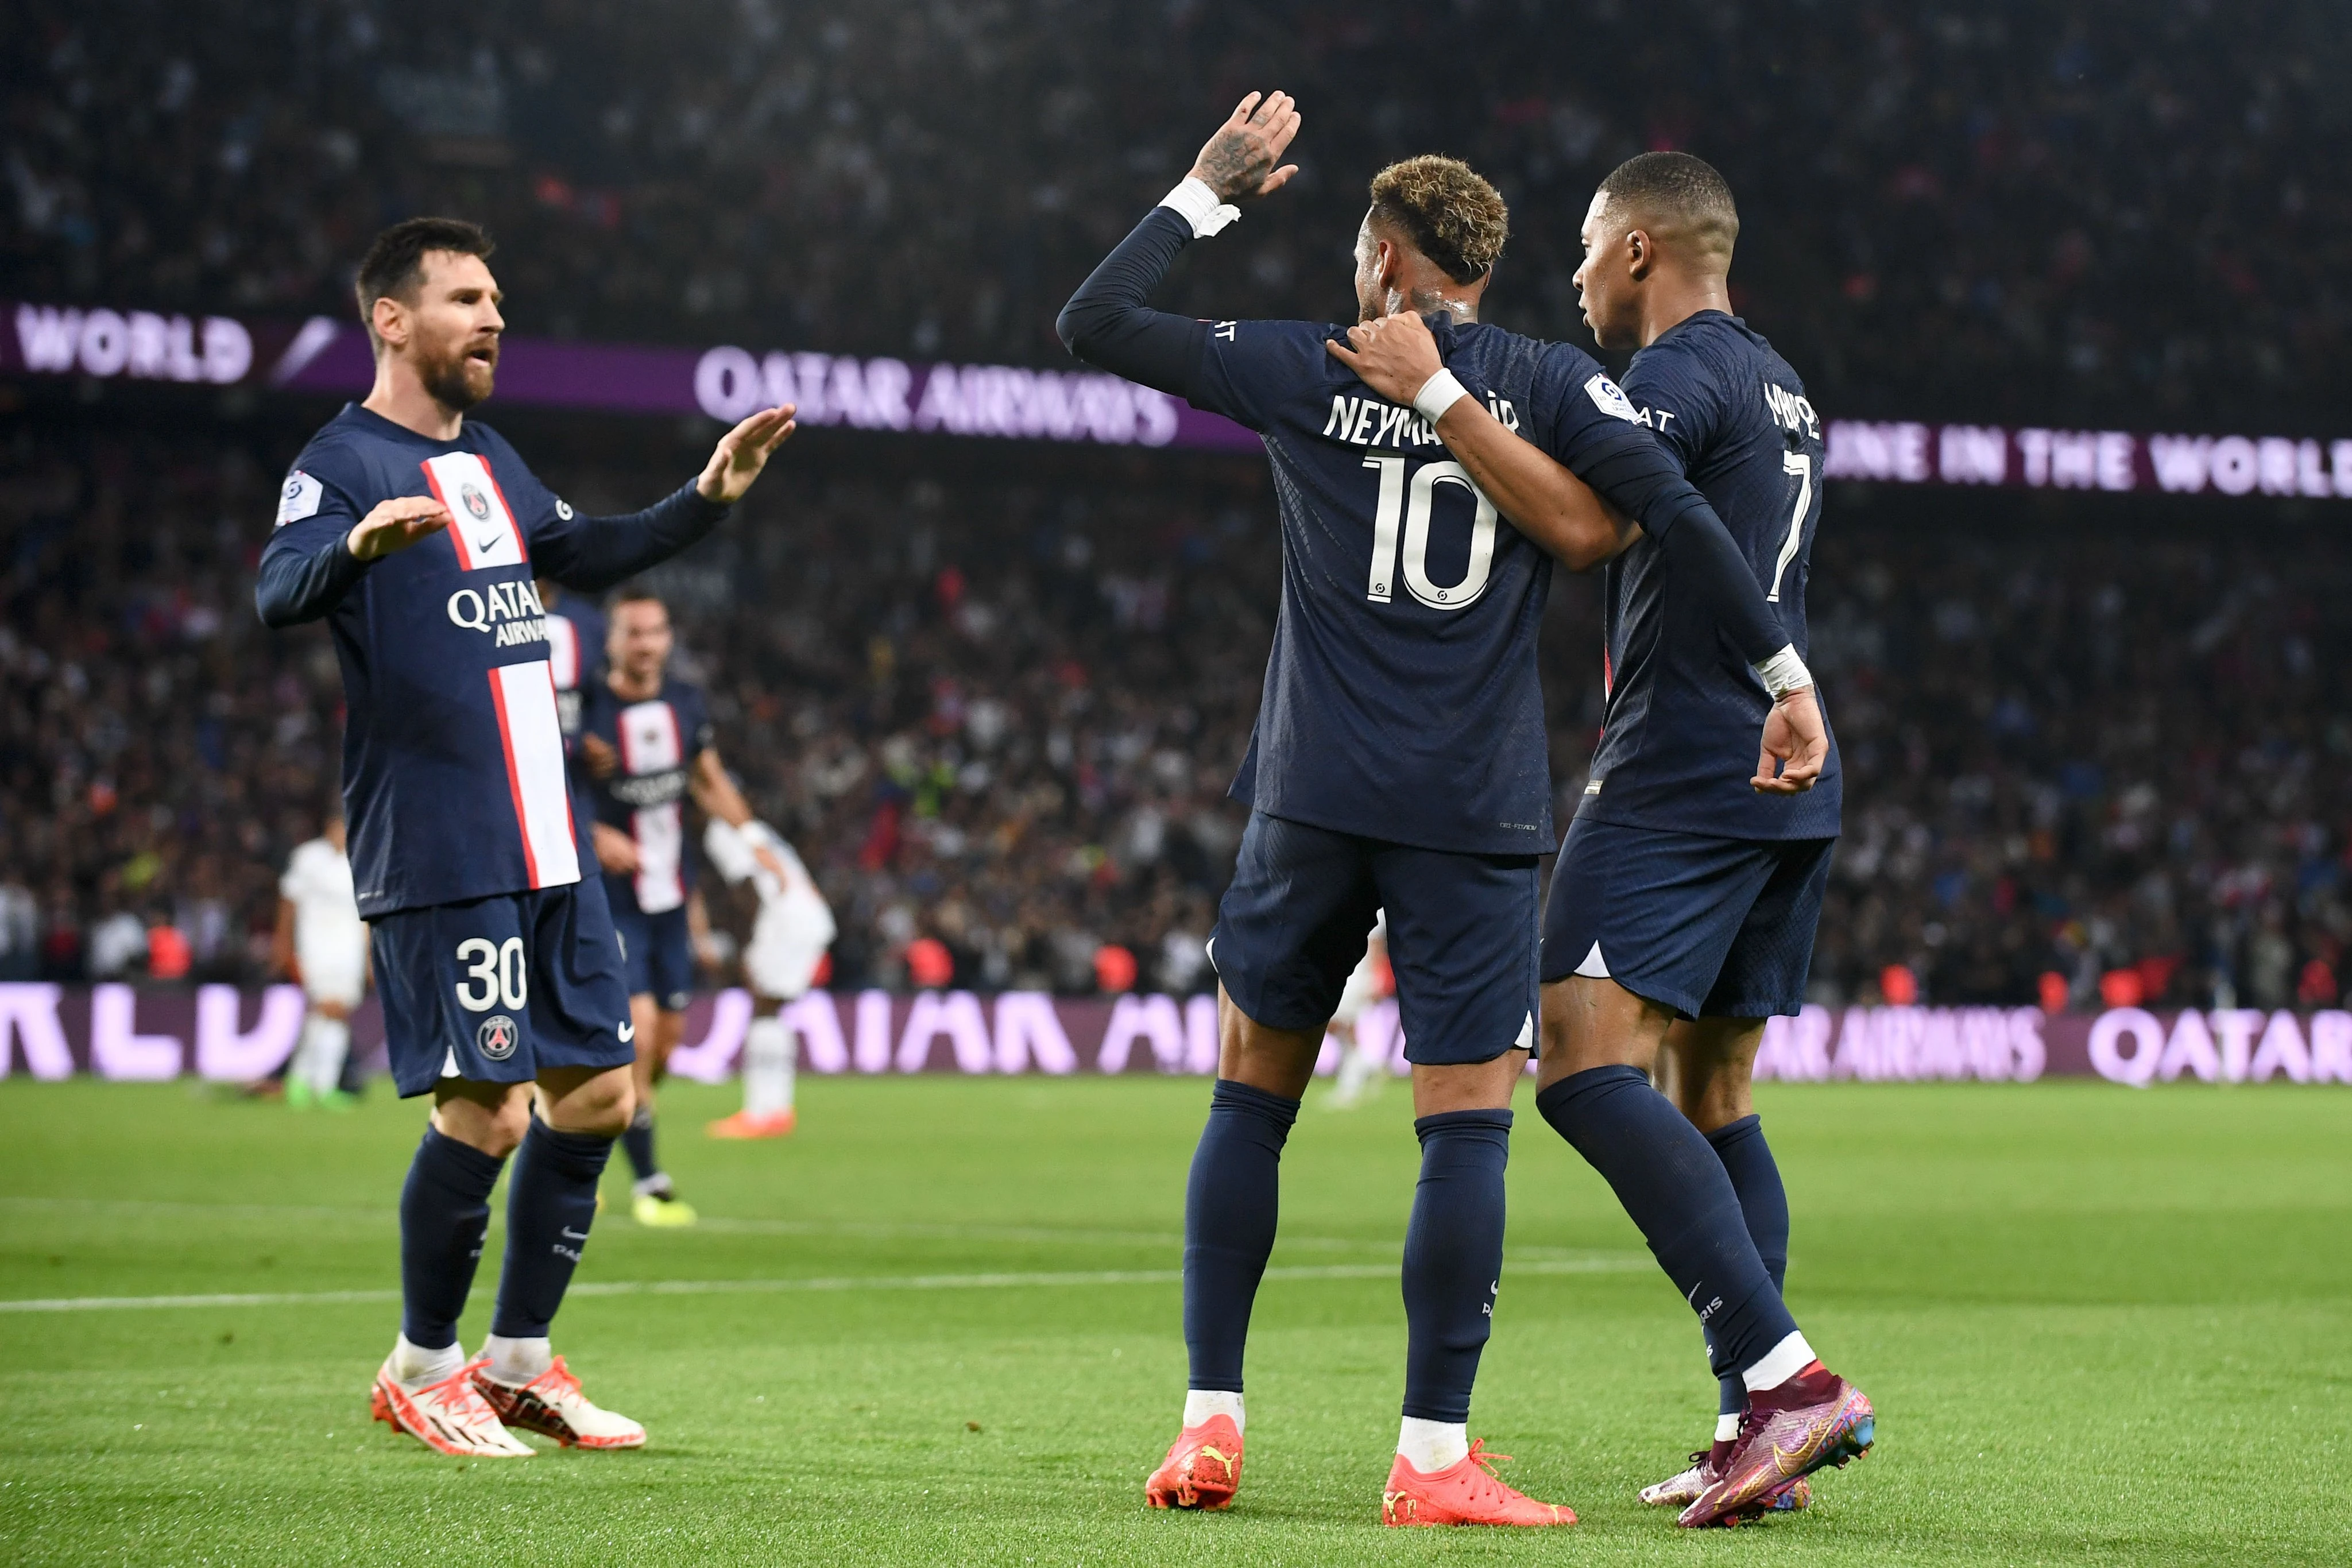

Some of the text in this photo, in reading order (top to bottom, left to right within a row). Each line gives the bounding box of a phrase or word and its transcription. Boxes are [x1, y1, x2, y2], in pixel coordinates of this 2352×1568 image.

[14, 303, 253, 385] WORLD
[694, 346, 1178, 448] QATAR AIRWAYS
[1939, 424, 2007, 485] IN
[2014, 427, 2137, 491] THE
[1361, 448, 1498, 610] 10
[1766, 450, 1811, 603] 7
[455, 936, 527, 1012] 30
[1835, 1004, 2048, 1083] AIRWAYS
[2087, 1006, 2352, 1090] QATAR
